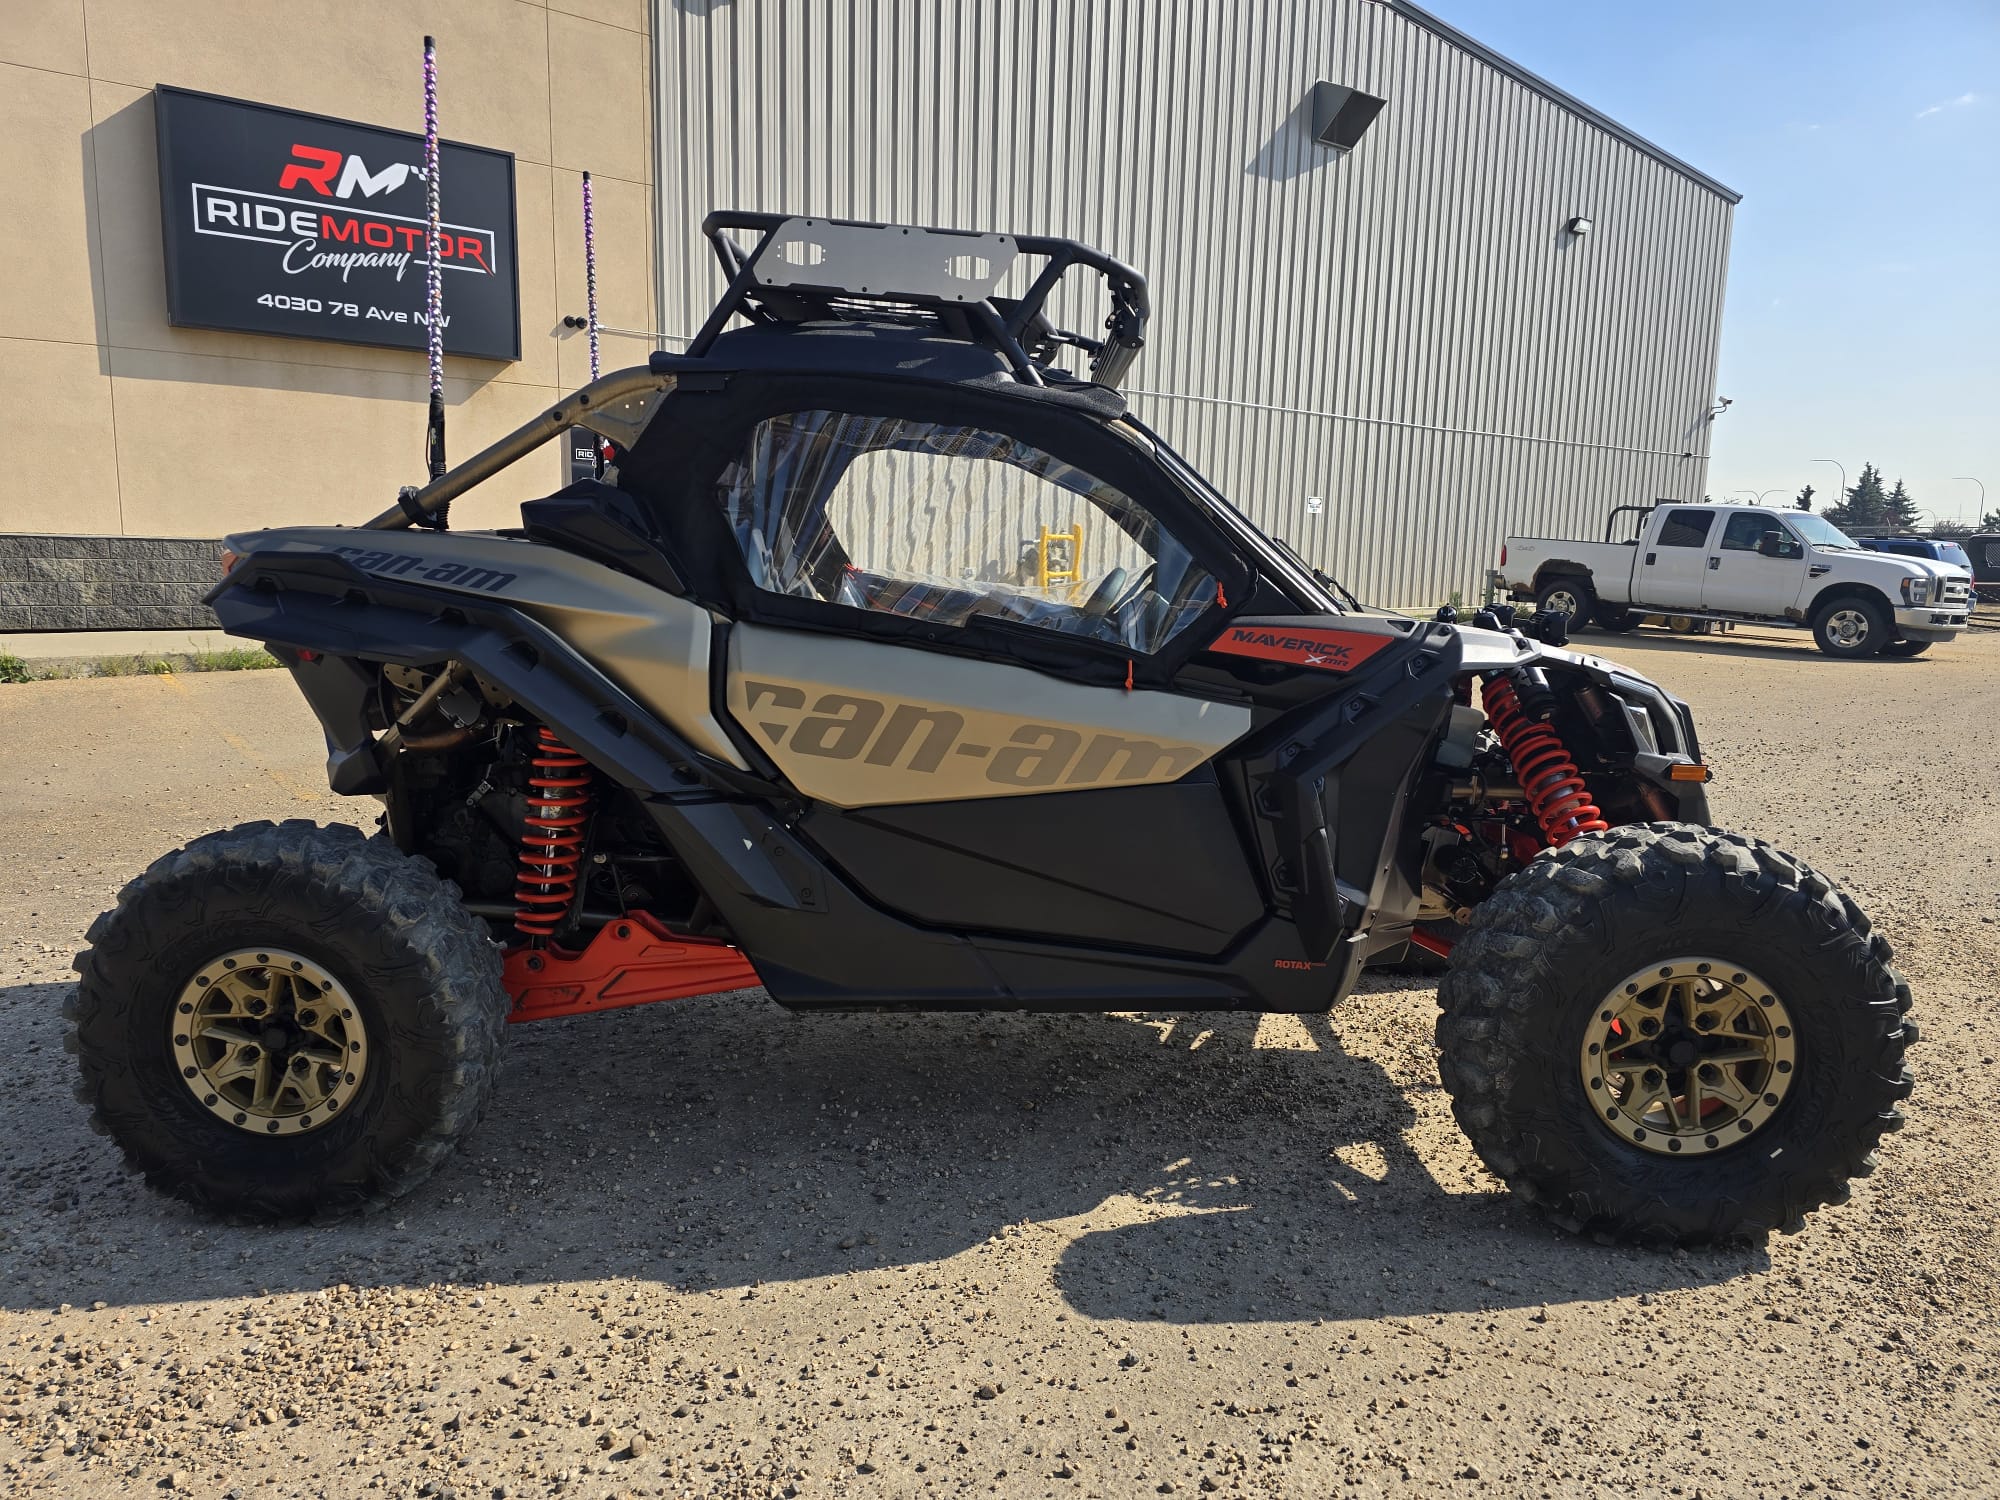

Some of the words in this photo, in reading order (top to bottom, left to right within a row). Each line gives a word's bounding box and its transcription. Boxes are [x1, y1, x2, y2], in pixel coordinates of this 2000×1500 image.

[279, 144, 410, 199] RM
[282, 238, 411, 283] Company
[257, 293, 323, 313] 4030
[328, 301, 360, 317] 78
[365, 307, 408, 323] Ave
[333, 547, 517, 592] can-am
[1231, 629, 1353, 658] MAVERICK
[744, 681, 1204, 787] can-am
[1274, 959, 1312, 970] ROTAX
